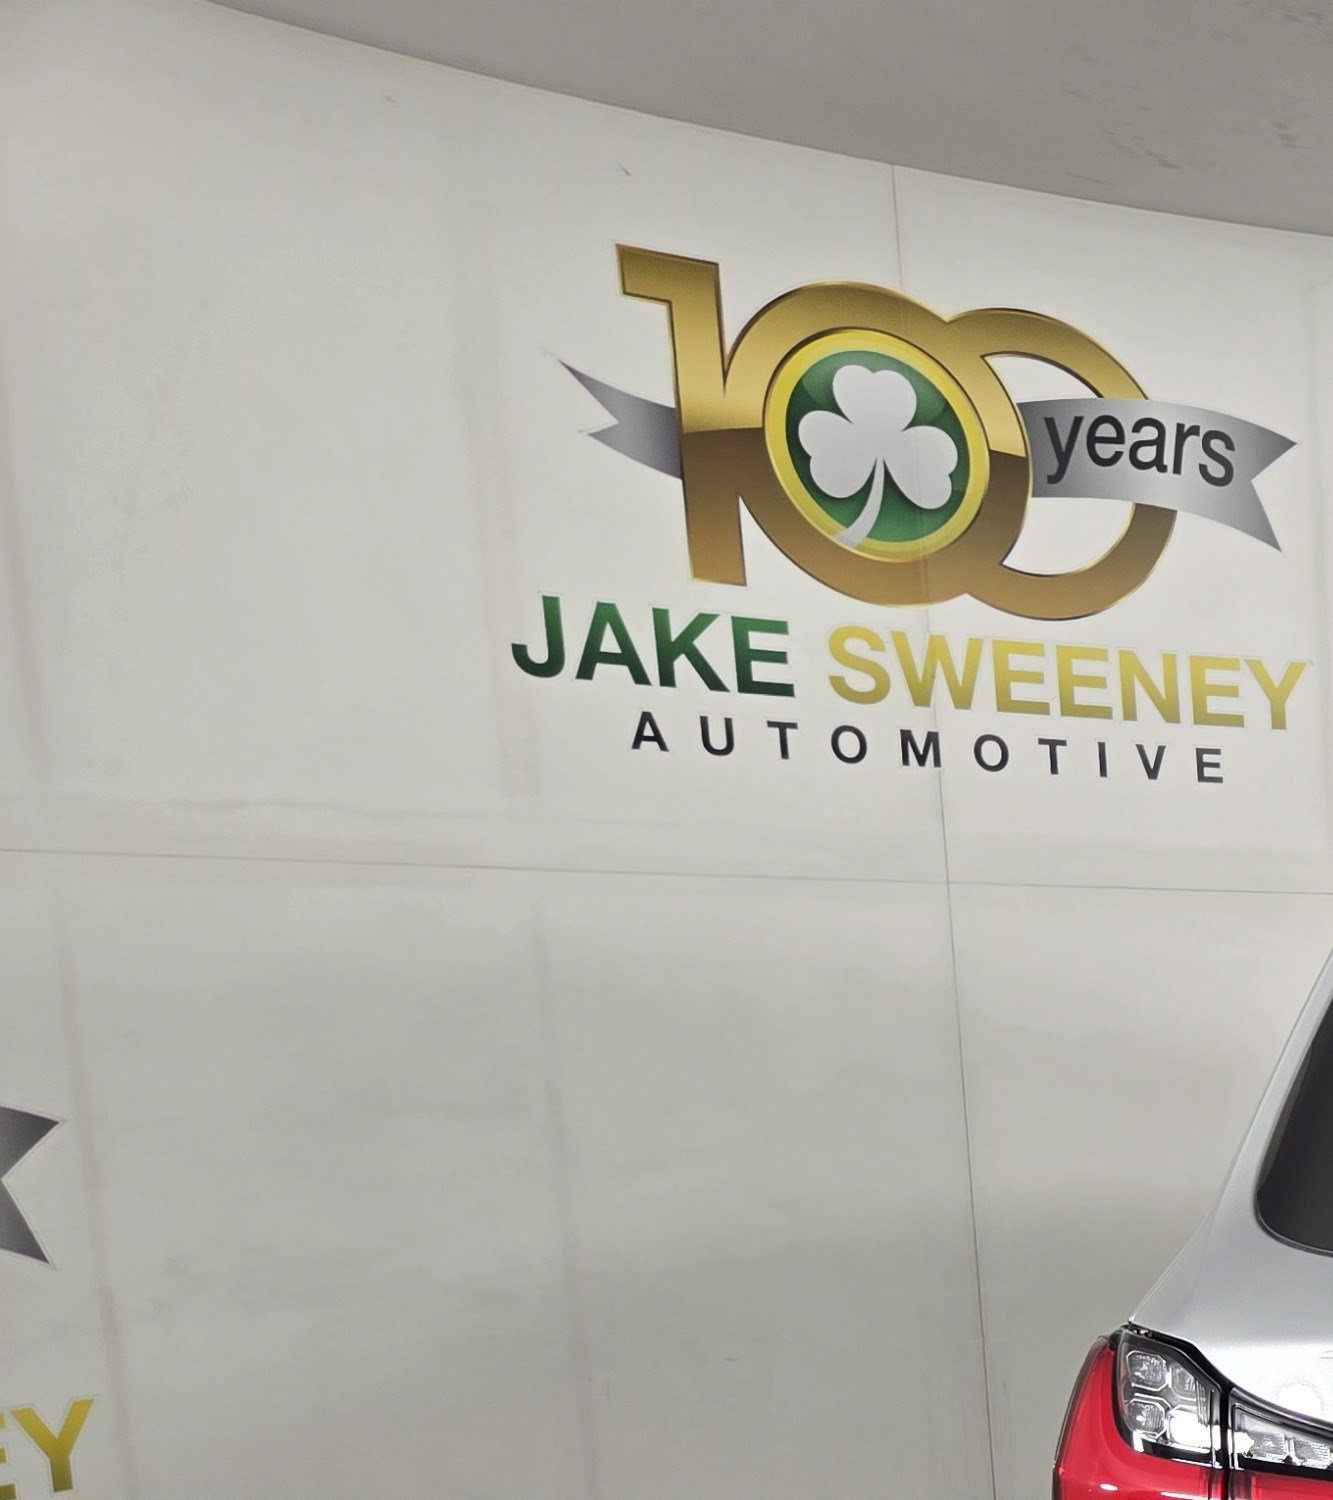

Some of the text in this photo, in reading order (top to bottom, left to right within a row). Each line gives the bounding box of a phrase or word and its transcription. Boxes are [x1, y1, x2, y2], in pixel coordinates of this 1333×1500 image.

[616, 243, 1236, 620] 100 years
[511, 594, 1308, 730] JAKE SWEENEY
[631, 710, 1224, 784] AUTOMOTIVE
